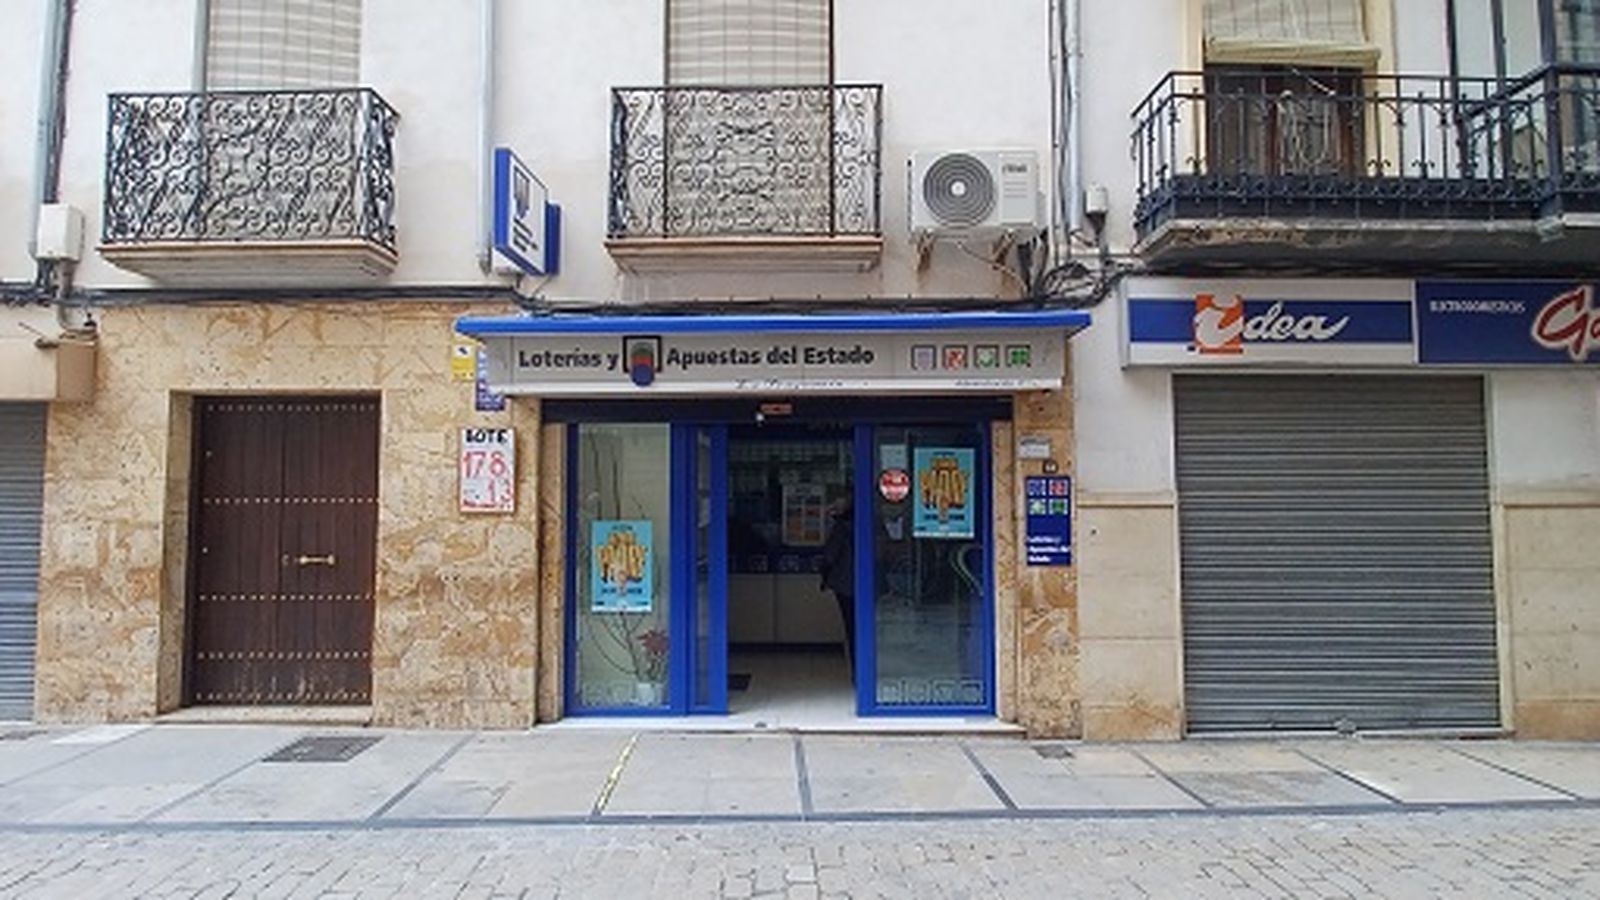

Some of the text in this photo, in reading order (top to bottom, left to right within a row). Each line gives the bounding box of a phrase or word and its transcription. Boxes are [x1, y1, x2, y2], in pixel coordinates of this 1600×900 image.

[519, 345, 874, 371] Loterías y Apuestas del Estado
